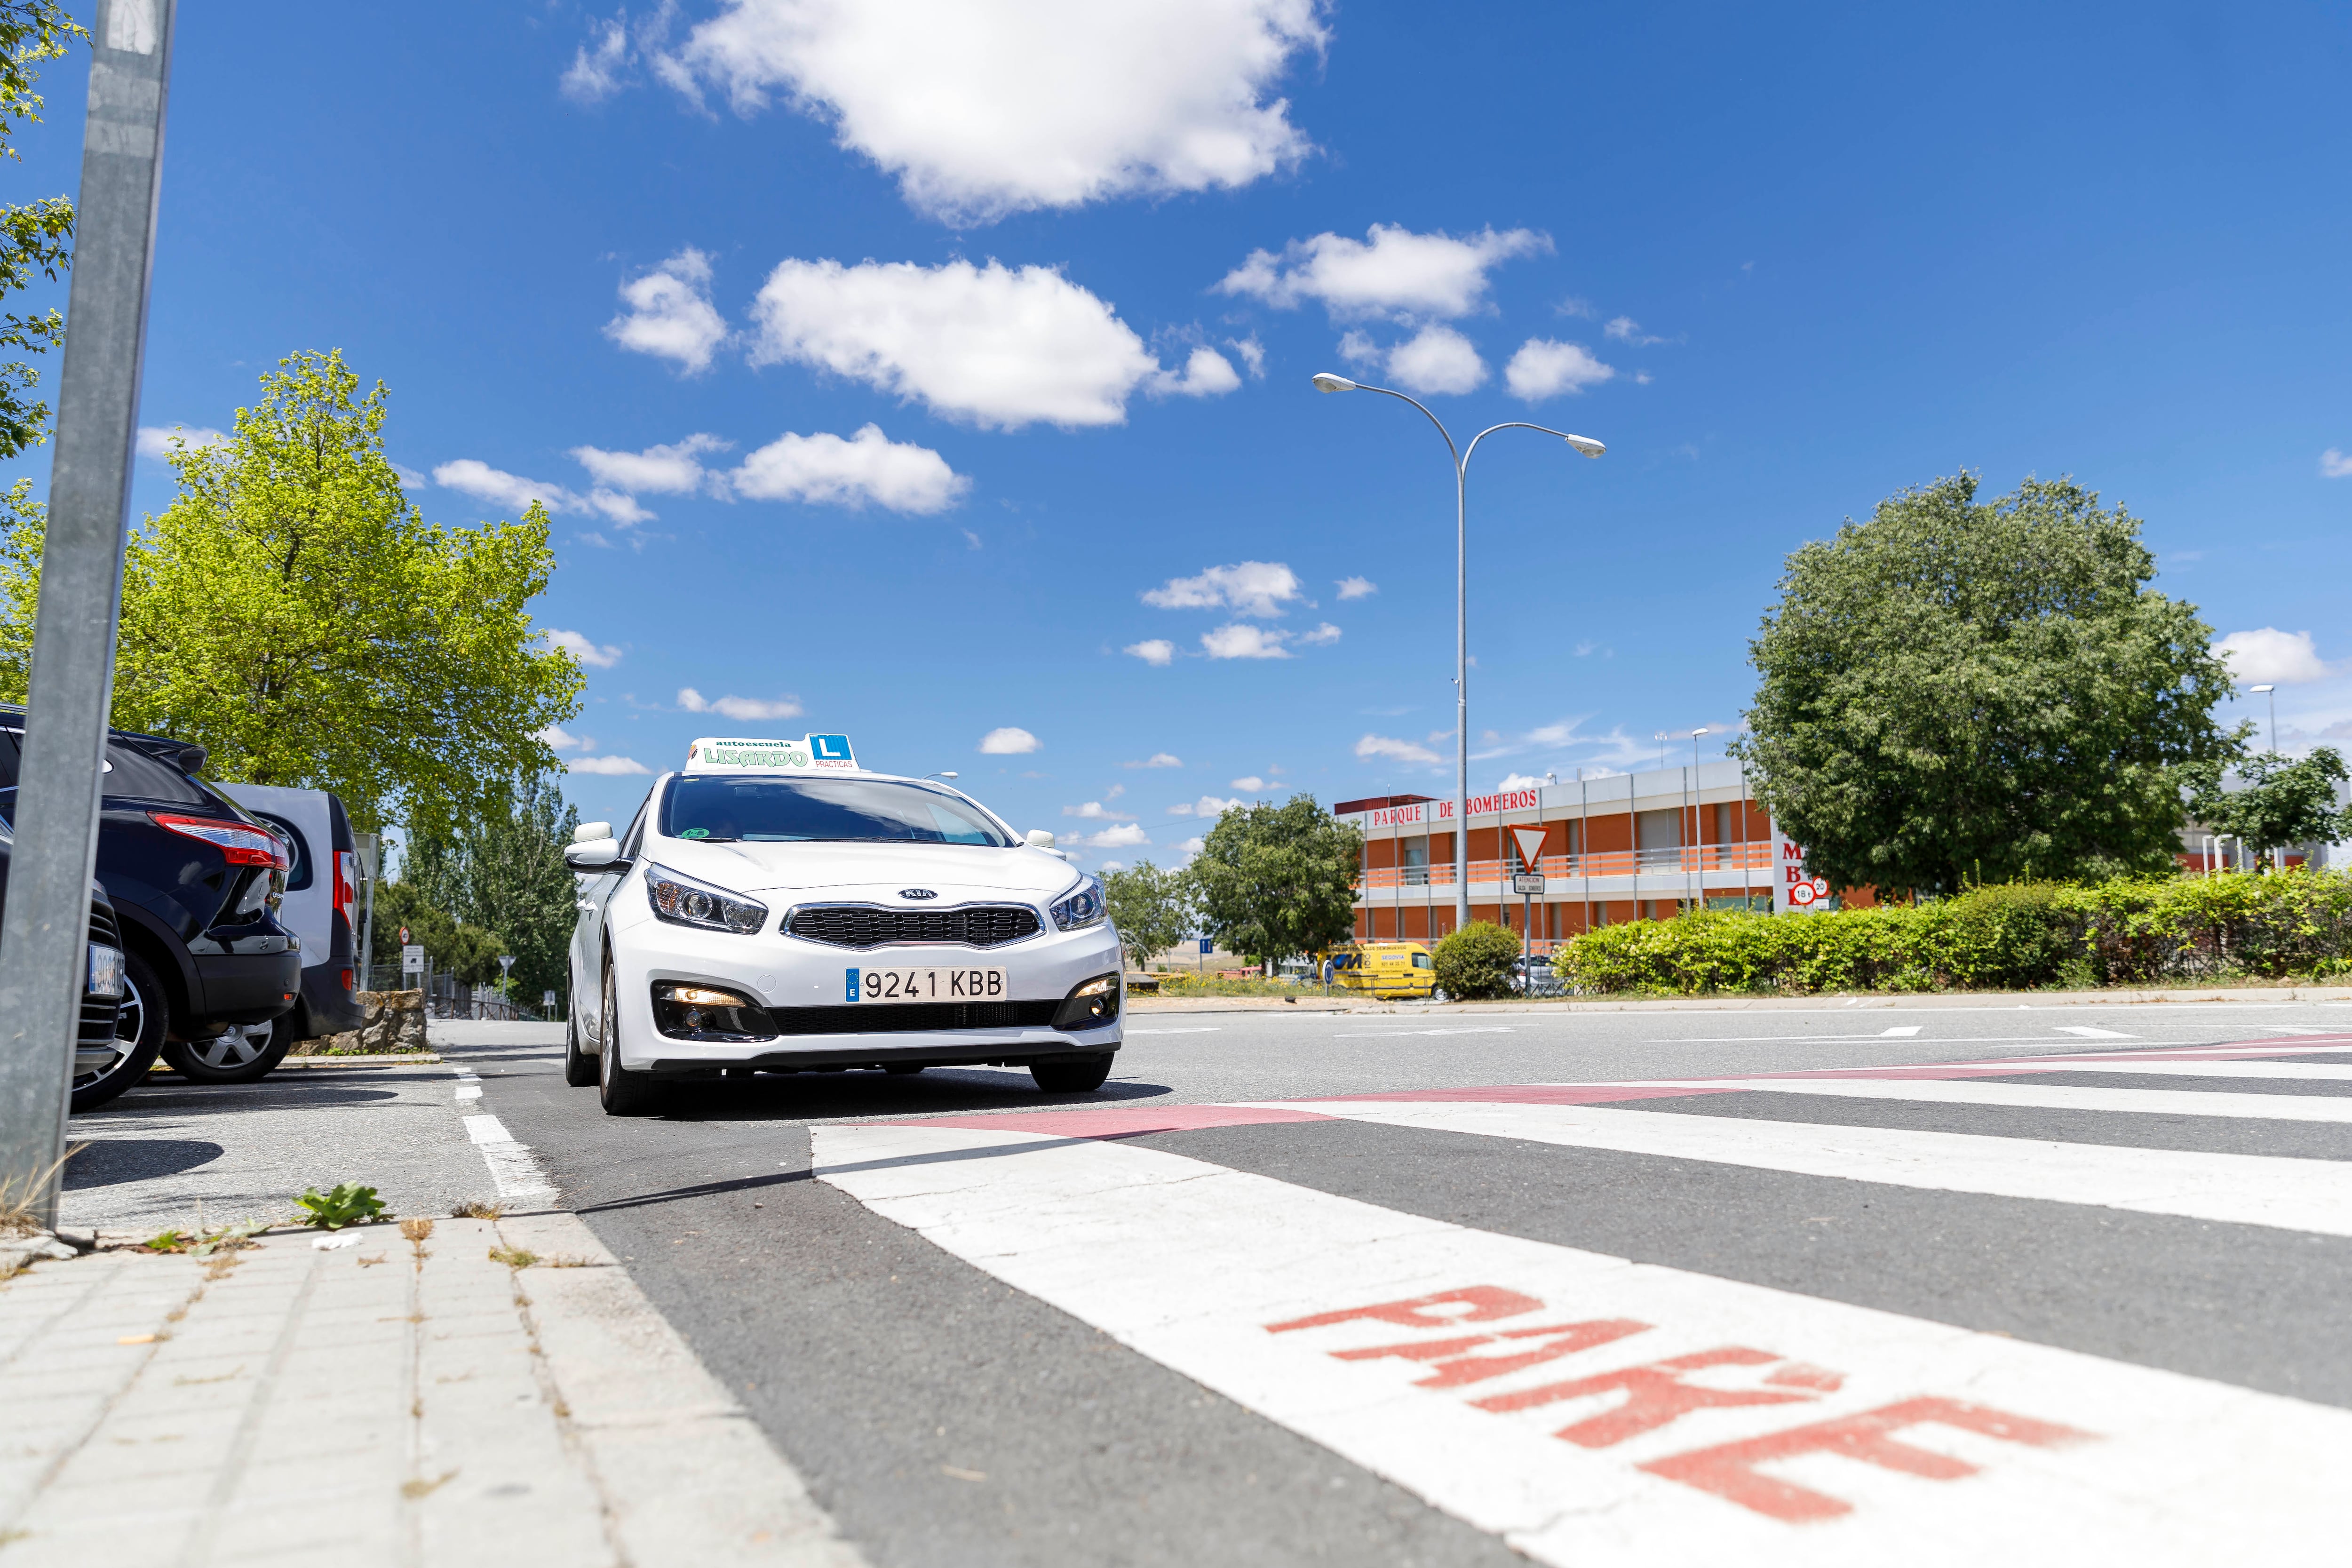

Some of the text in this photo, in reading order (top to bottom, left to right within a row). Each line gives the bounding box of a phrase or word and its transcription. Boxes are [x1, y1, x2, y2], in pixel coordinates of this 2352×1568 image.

[704, 748, 808, 767] LISARDO
[819, 739, 841, 756] L
[1374, 790, 1536, 826] PARQUE DE BOMBEROS
[866, 971, 1001, 998] 9241 KBB
[1263, 1285, 2107, 1525] PARE
